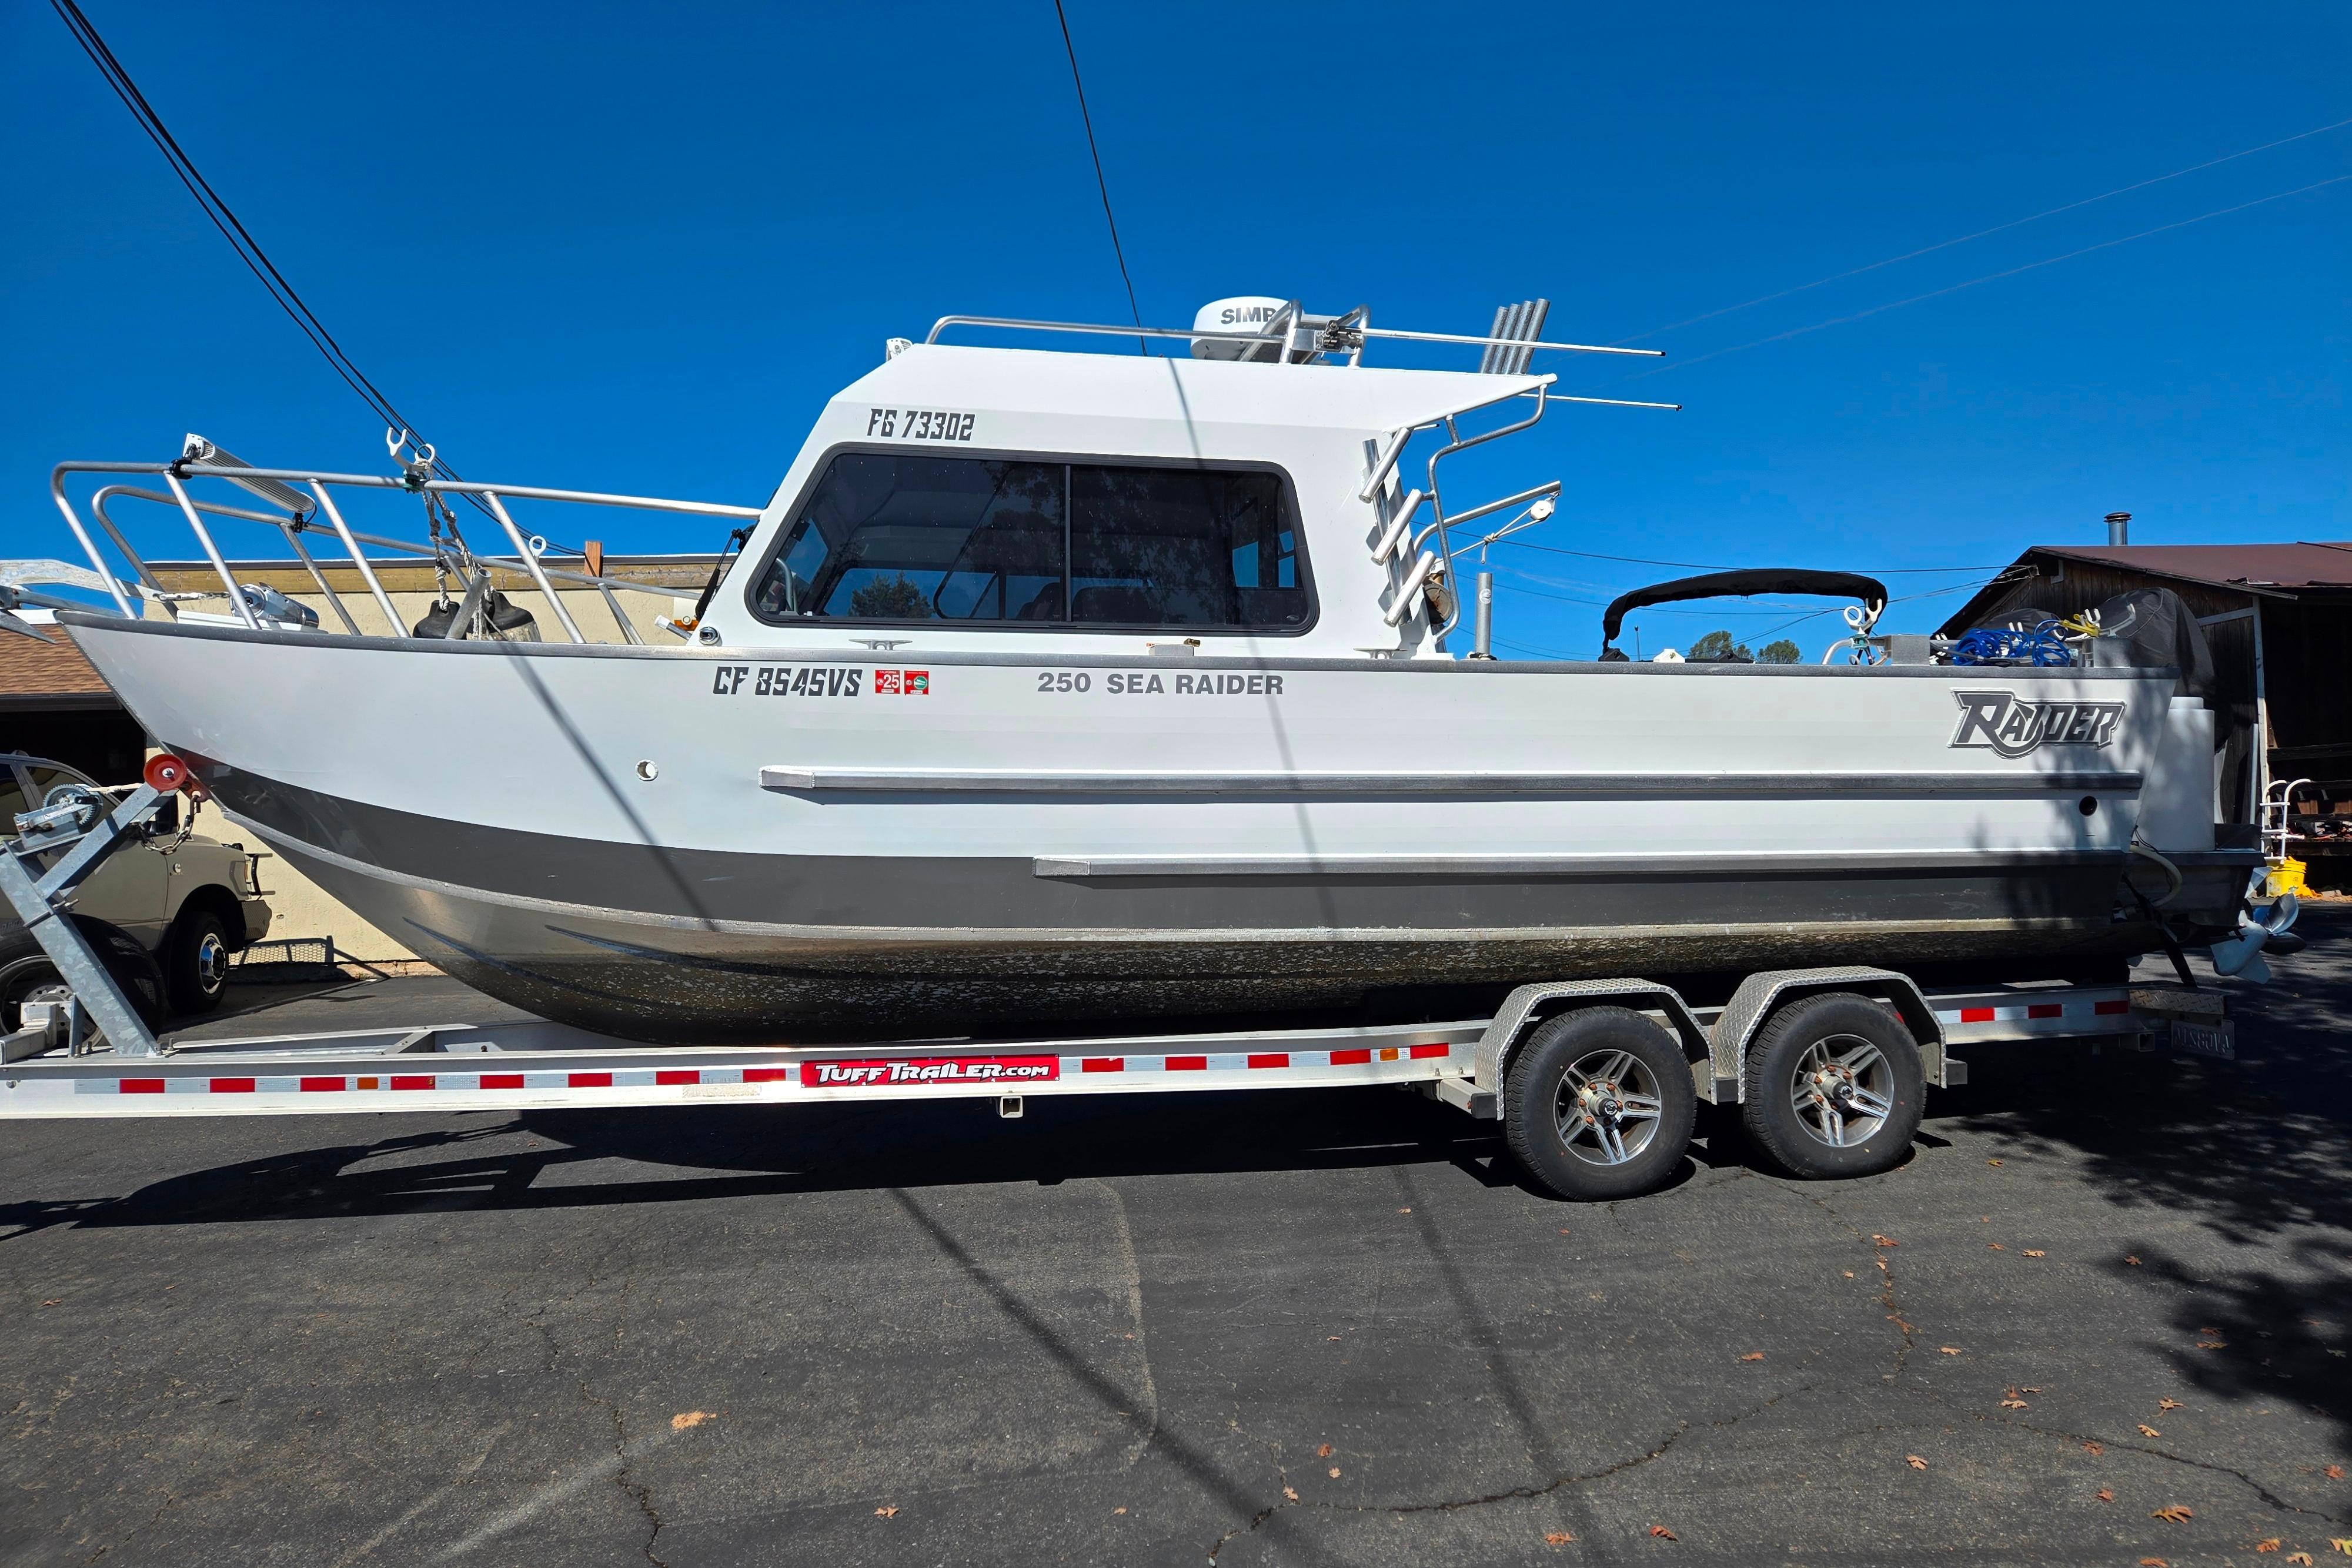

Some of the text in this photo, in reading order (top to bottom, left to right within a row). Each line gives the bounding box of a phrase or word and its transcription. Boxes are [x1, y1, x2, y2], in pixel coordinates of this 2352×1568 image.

[867, 408, 975, 441] FG 73302
[713, 666, 863, 696] CF 8545VS
[883, 674, 899, 688] 25
[1038, 672, 1283, 694] 250 SEA RAIDER
[1949, 688, 2126, 758] RAIDER
